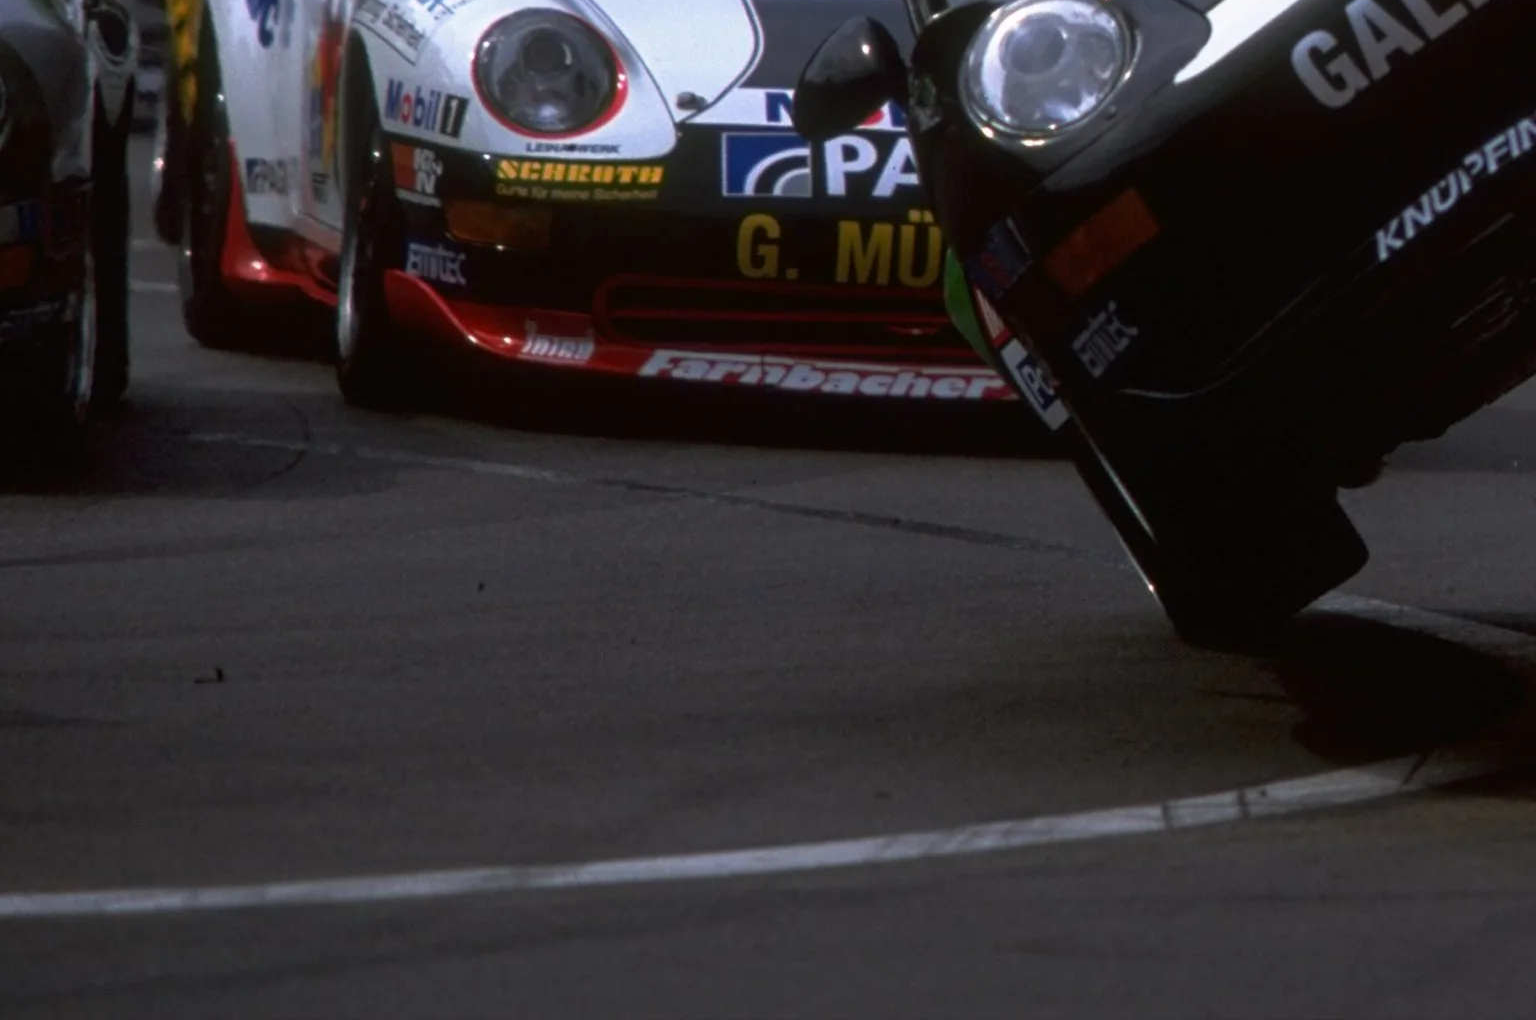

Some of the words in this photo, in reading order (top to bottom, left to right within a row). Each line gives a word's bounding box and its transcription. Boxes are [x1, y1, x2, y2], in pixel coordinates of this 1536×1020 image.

[386, 78, 438, 132] Mobil
[496, 159, 666, 185] SCHROTH
[736, 213, 798, 280] G.
[836, 209, 942, 287] MÜ
[638, 350, 1006, 399] Farnbacher
